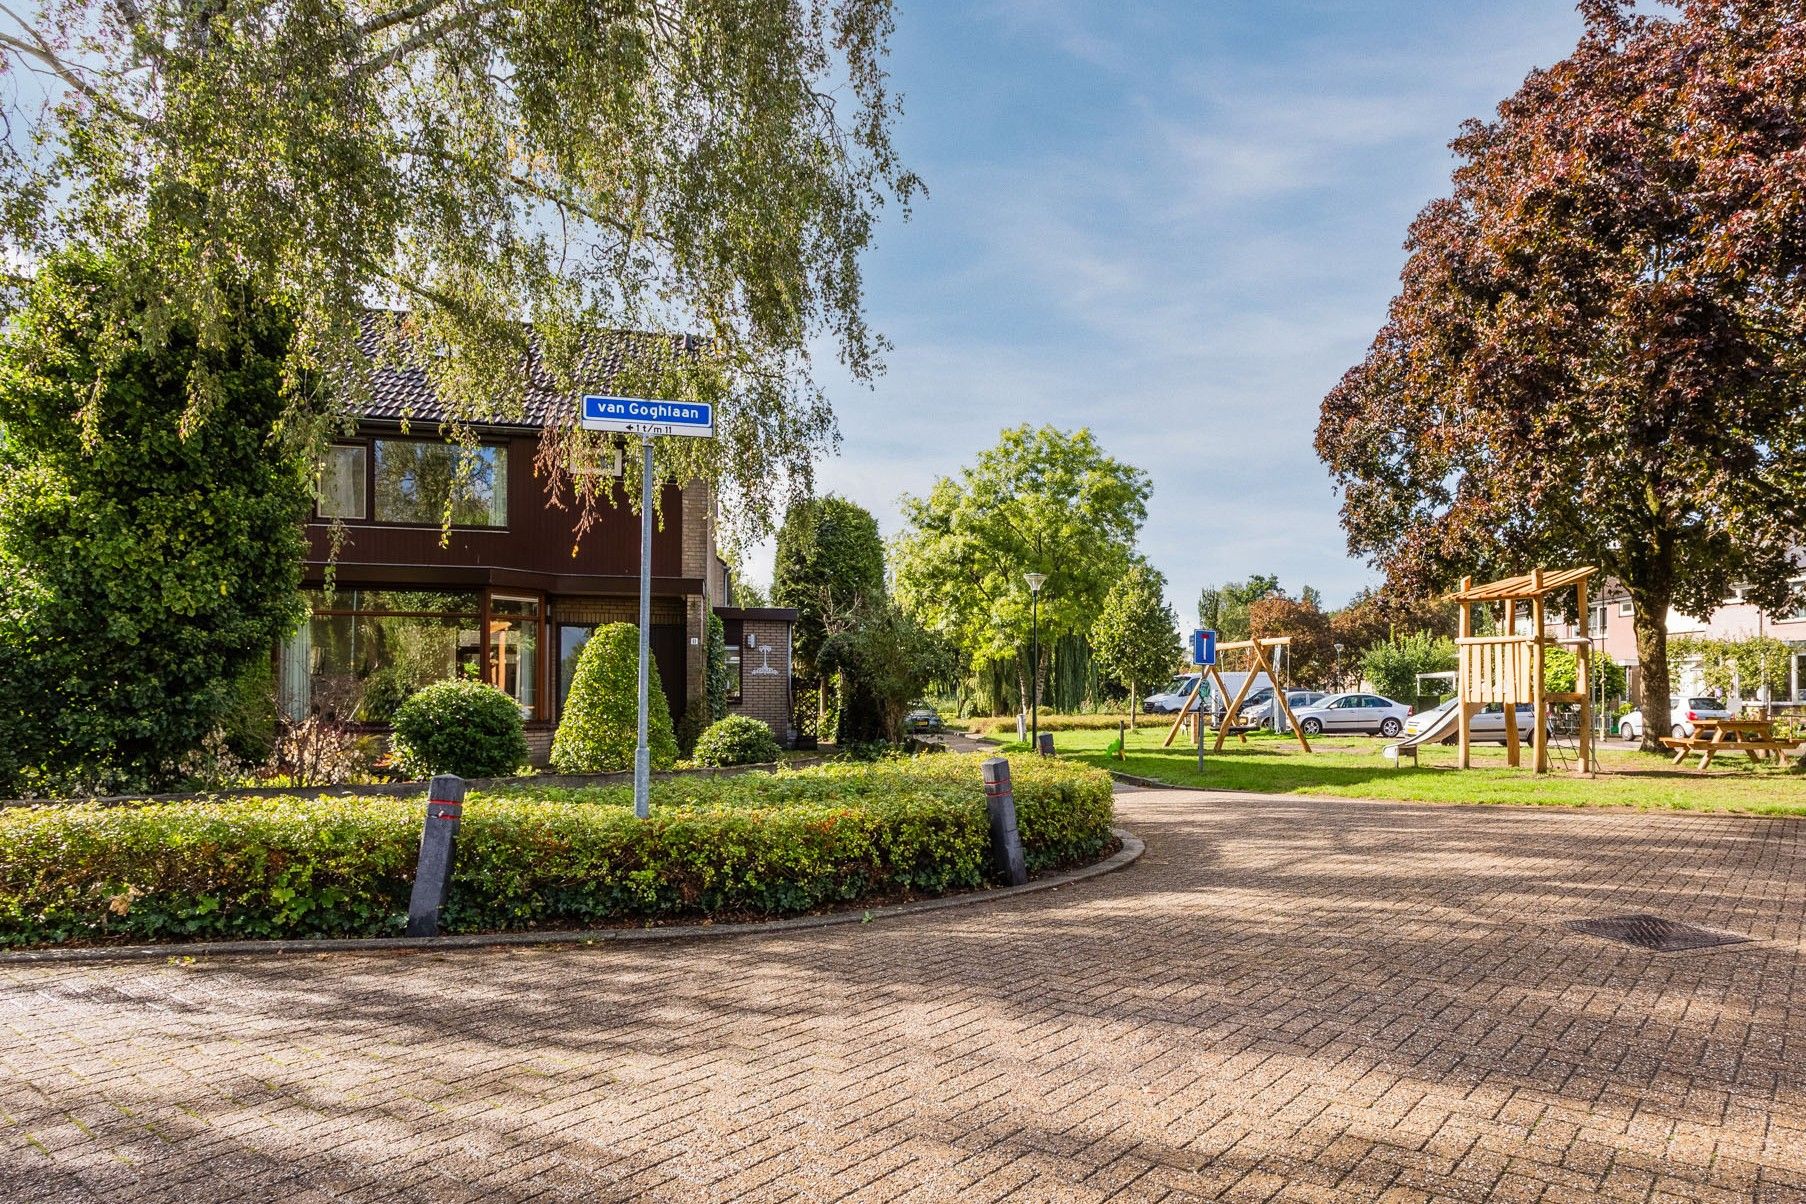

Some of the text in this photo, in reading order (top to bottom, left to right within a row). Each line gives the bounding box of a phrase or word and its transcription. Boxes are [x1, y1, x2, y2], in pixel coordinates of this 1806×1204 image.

[597, 402, 699, 419] van Goghlaan
[642, 424, 662, 434] t/m
[665, 425, 672, 434] 11
